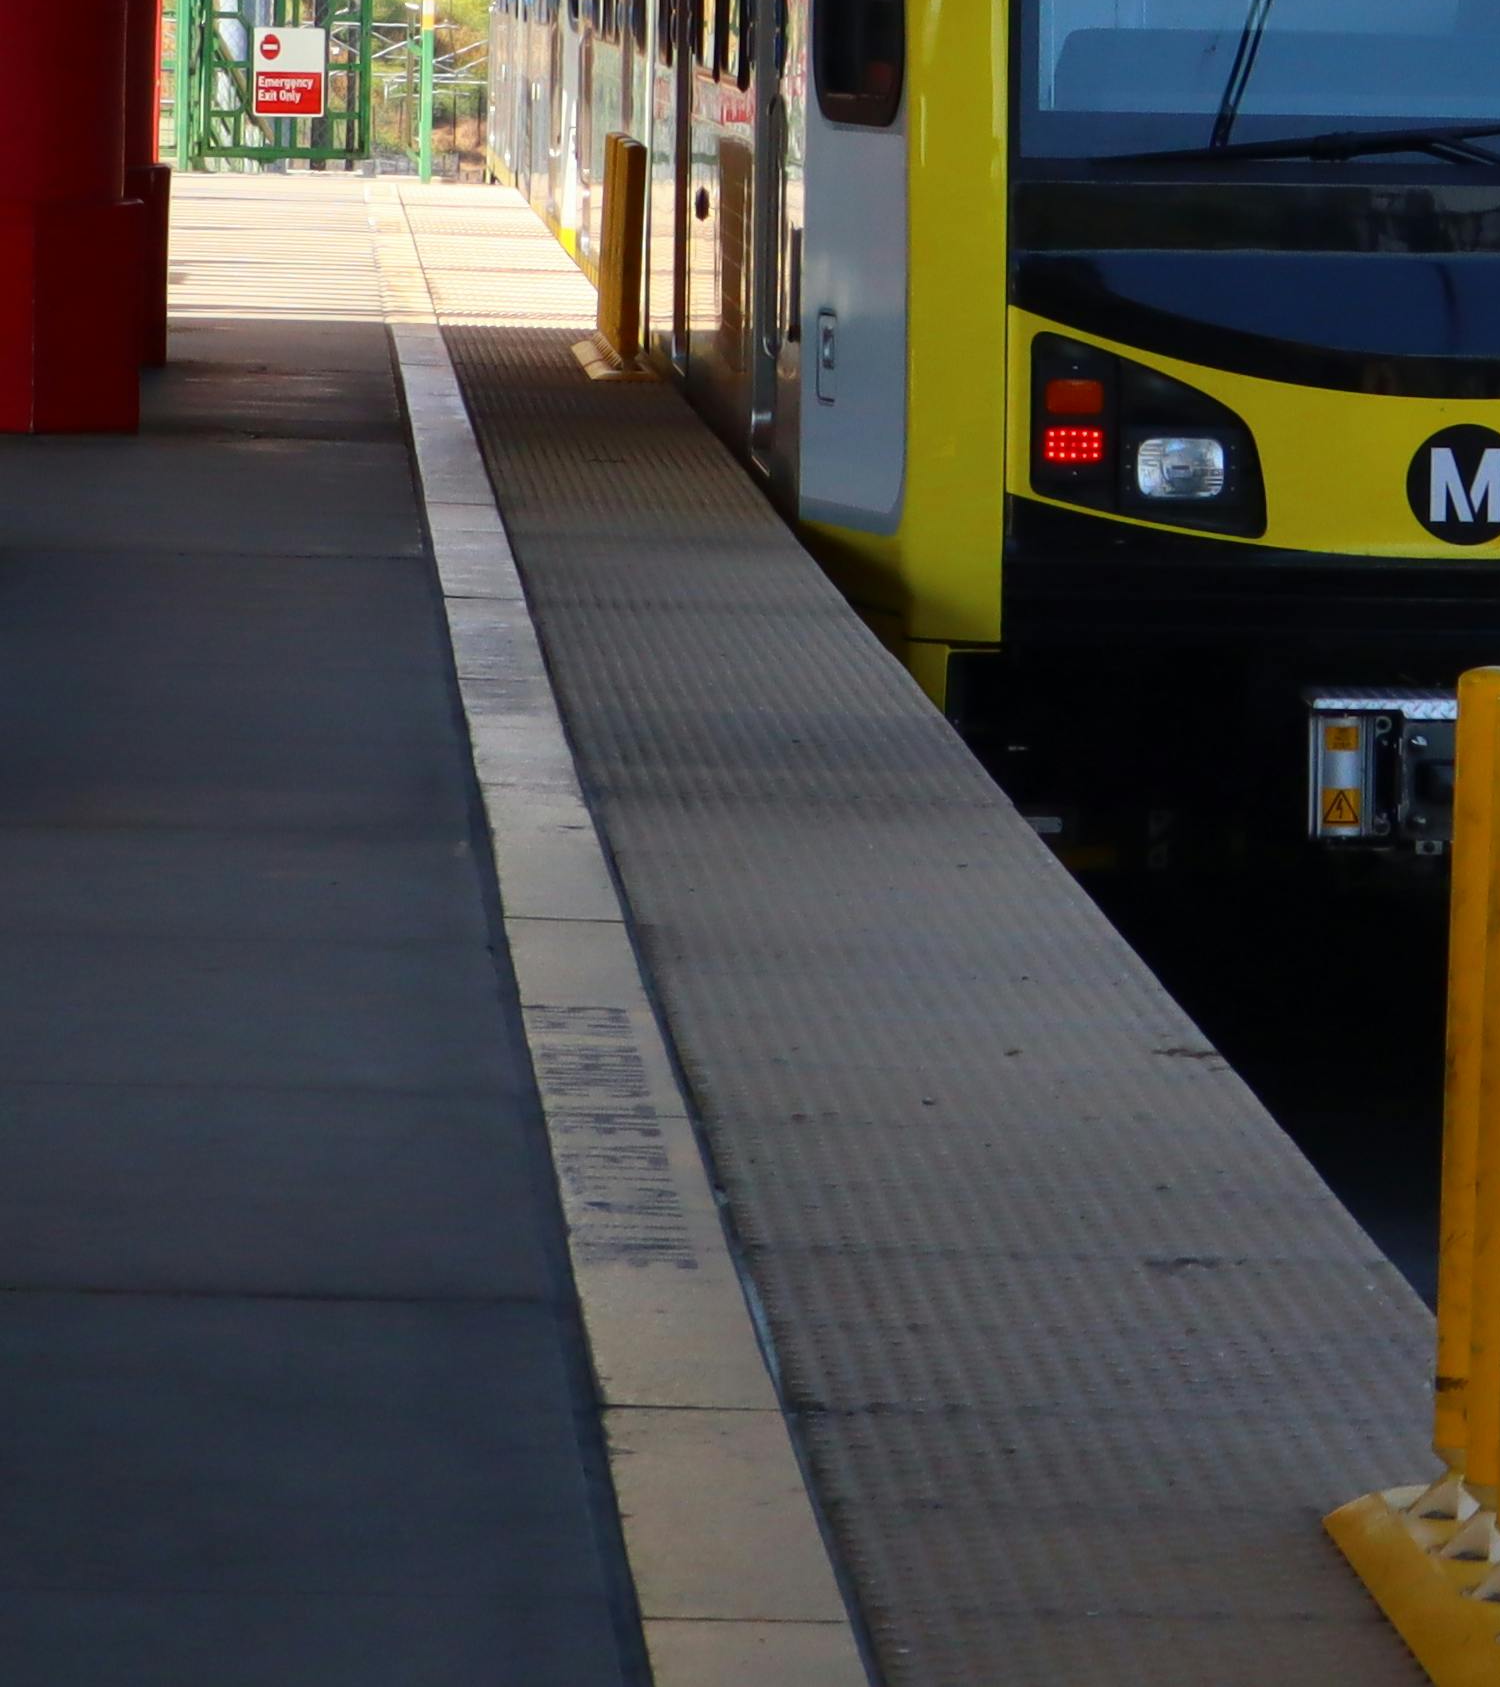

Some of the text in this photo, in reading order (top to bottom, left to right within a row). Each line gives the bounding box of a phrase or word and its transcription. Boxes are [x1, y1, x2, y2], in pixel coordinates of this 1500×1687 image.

[258, 76, 314, 90] Emergency
[258, 90, 302, 104] Exit Only
